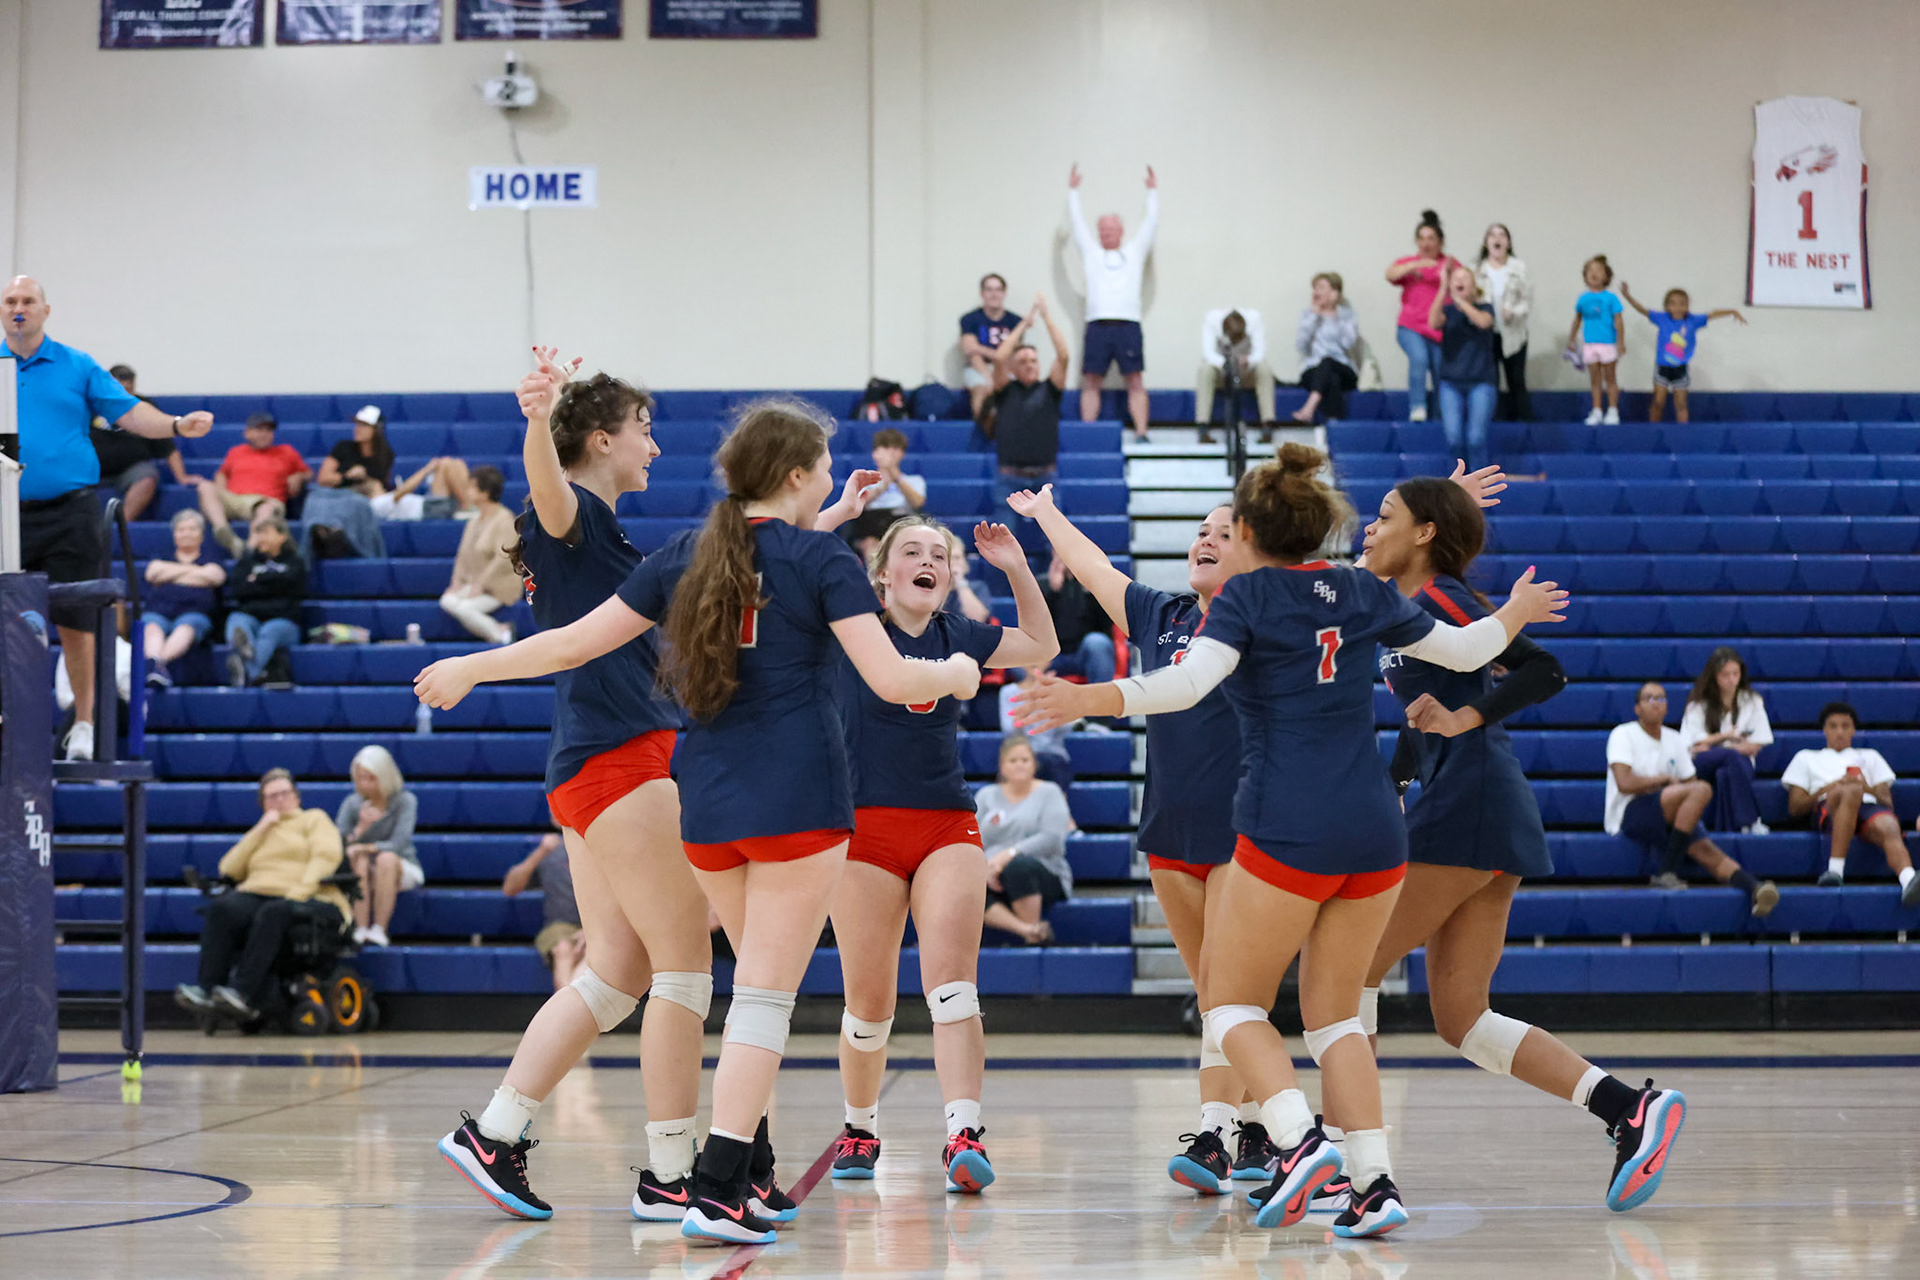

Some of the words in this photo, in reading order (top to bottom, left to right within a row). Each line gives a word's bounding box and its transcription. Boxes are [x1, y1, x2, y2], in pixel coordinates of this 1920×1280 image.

[486, 173, 581, 200] HOME
[1798, 190, 1817, 239] 1
[1765, 252, 1797, 268] THE
[1806, 253, 1850, 269] NEST
